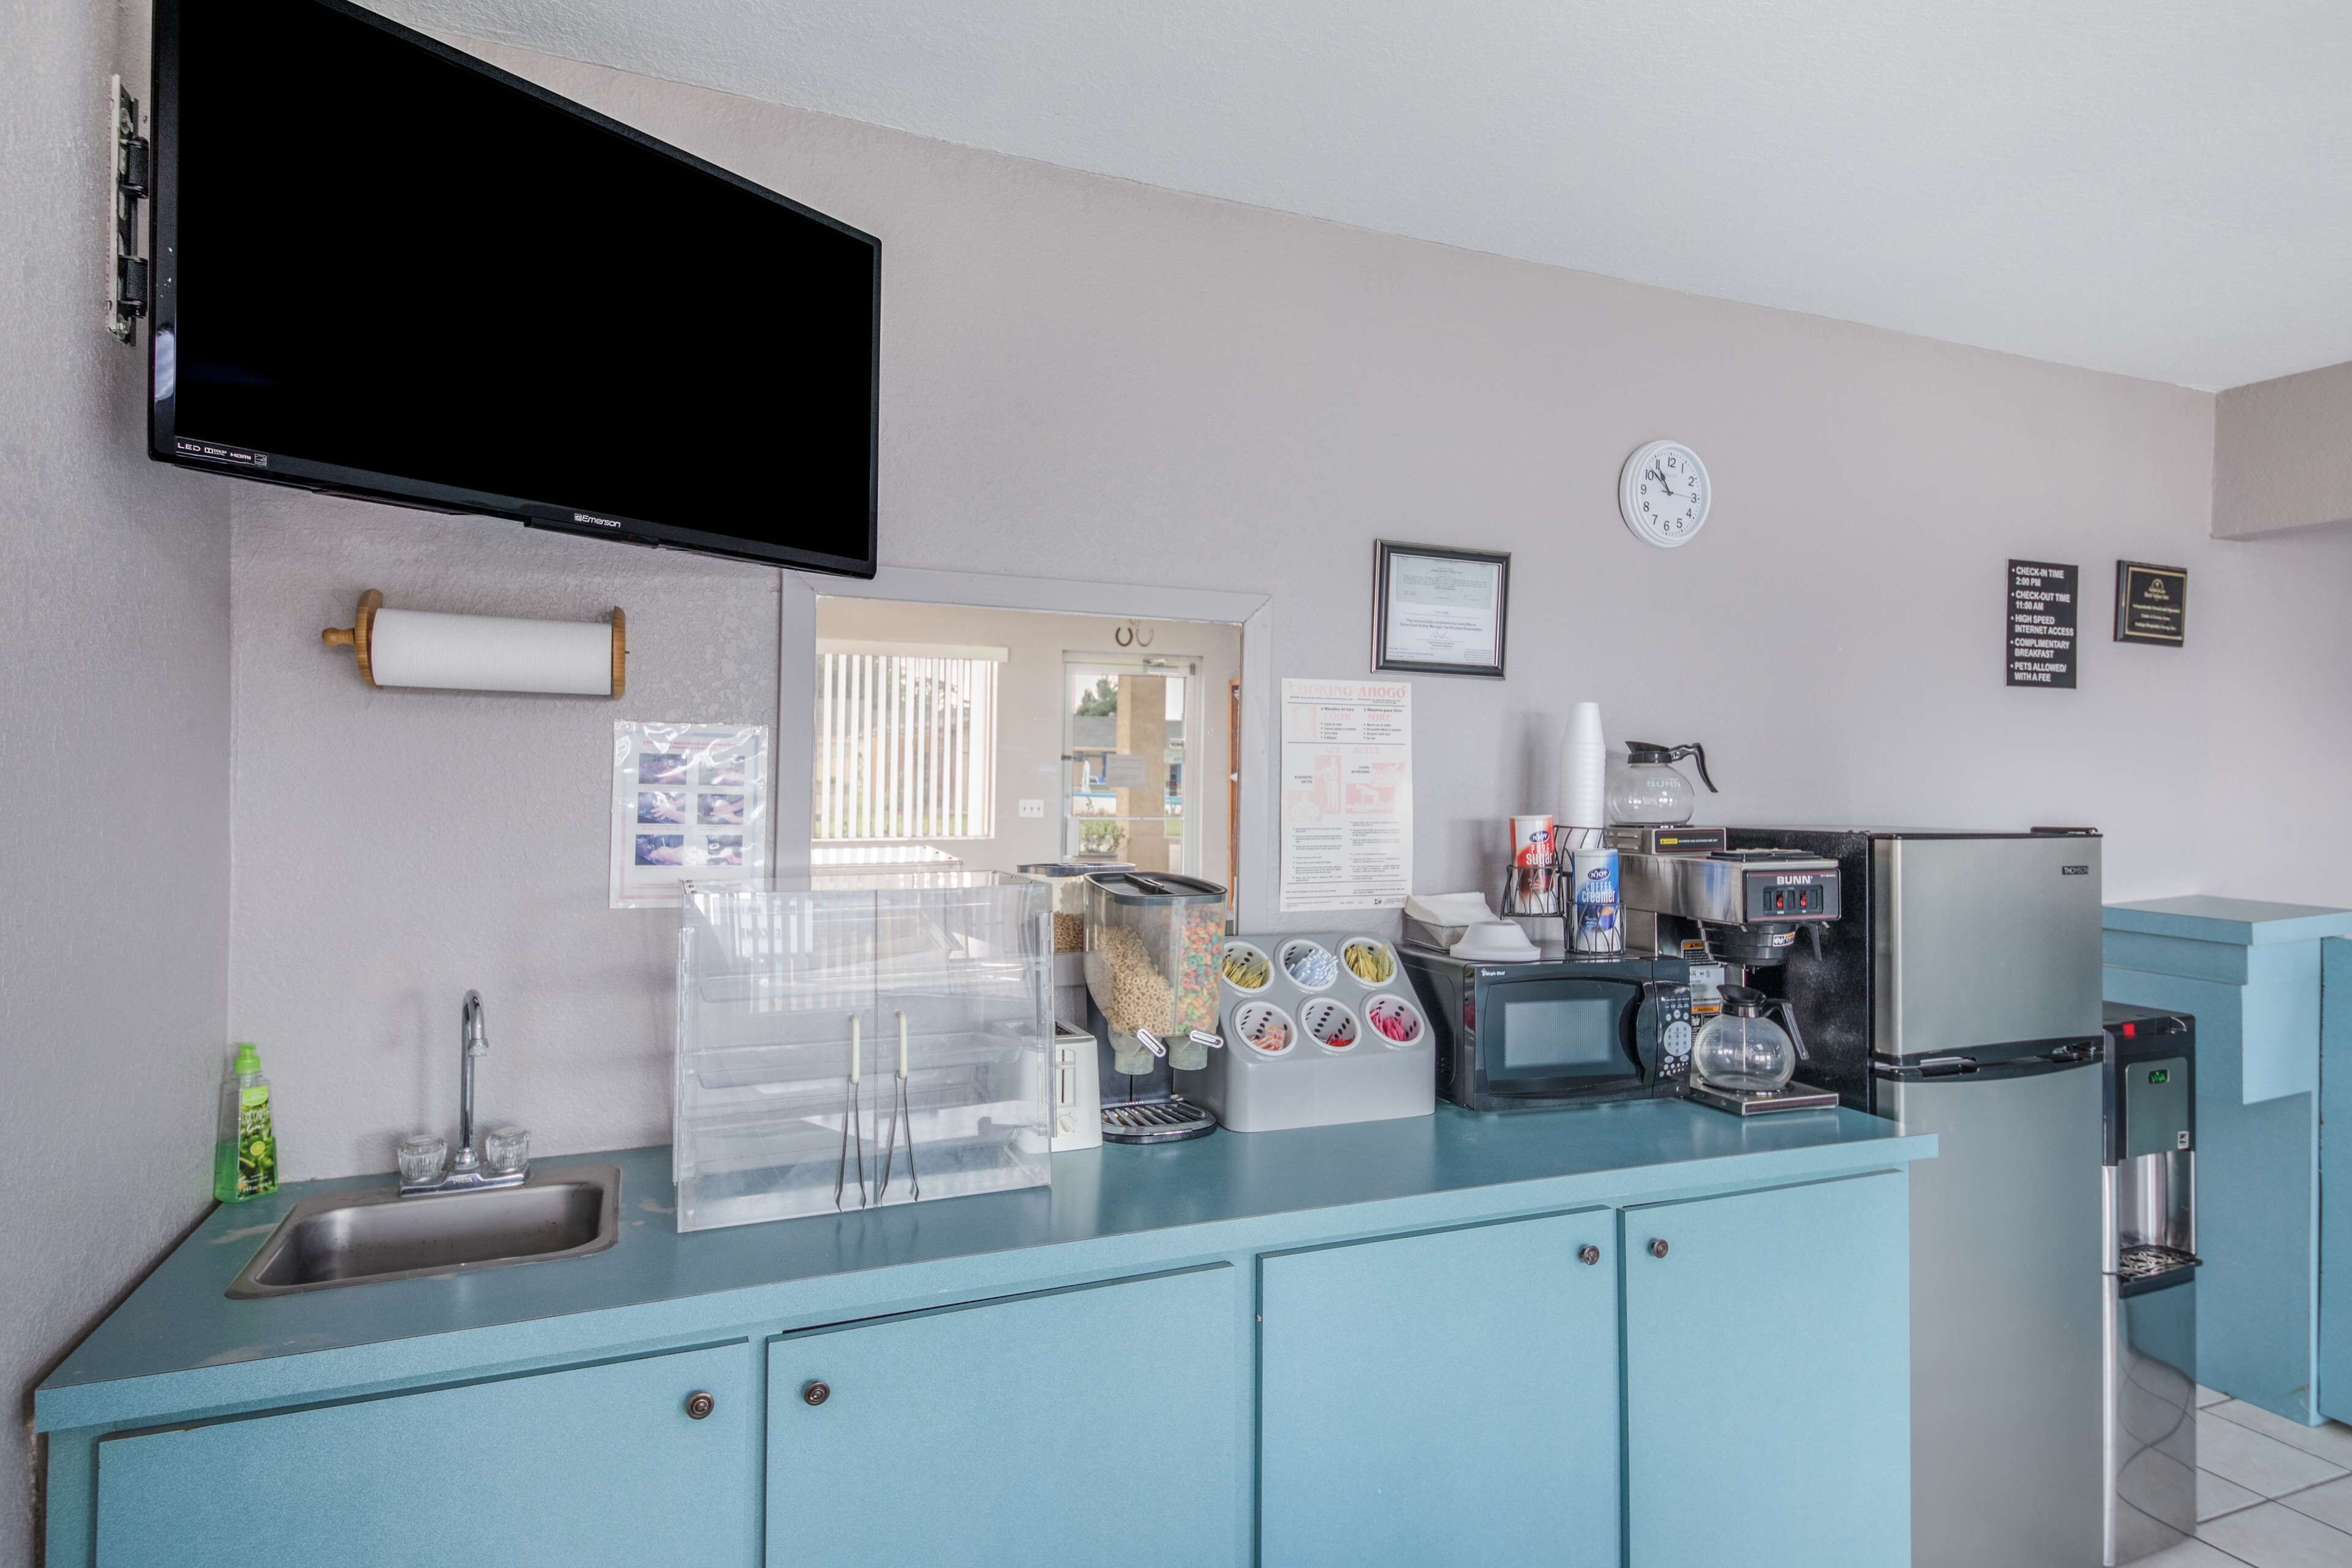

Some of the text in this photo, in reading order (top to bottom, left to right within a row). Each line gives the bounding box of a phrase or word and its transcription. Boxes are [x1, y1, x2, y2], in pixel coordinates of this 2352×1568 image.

[178, 442, 201, 451] LED
[1656, 459, 1660, 470] 11
[1668, 457, 1676, 468] 12
[1681, 463, 1684, 473] 1
[1645, 469, 1654, 480] 10
[1688, 476, 1694, 486] 2
[1640, 484, 1646, 494] 9
[1691, 493, 1697, 503] 3
[1643, 501, 1649, 511] 8
[1686, 508, 1692, 518] 4
[582, 515, 621, 527] Emerson
[1652, 514, 1658, 524] 7
[1676, 518, 1683, 529] 5
[1664, 520, 1670, 531] 6
[2016, 566, 2065, 579] CHECK-IN TIME
[2016, 576, 2041, 587] 2:00 PM
[2016, 590, 2071, 603] CHECK-OUT TIME
[2016, 601, 2044, 611] 11:00 AM
[2015, 614, 2055, 625] HIGH SPEED
[2015, 624, 2074, 636] INTERNET ACCESS
[2015, 638, 2070, 649] COMPLIMENTARY
[2015, 648, 2054, 658] BREAKFAST
[2015, 662, 2032, 671] PETS
[2015, 672, 2051, 682] WITH A FEE
[1358, 686, 1406, 699] AHOGO
[1647, 779, 1681, 788] BUNN
[1532, 843, 1550, 853] PURE
[1526, 852, 1553, 867] sugar
[1777, 875, 1811, 885] BUNN
[1586, 881, 1612, 892] COFFEE
[1582, 890, 1616, 903] creamer
